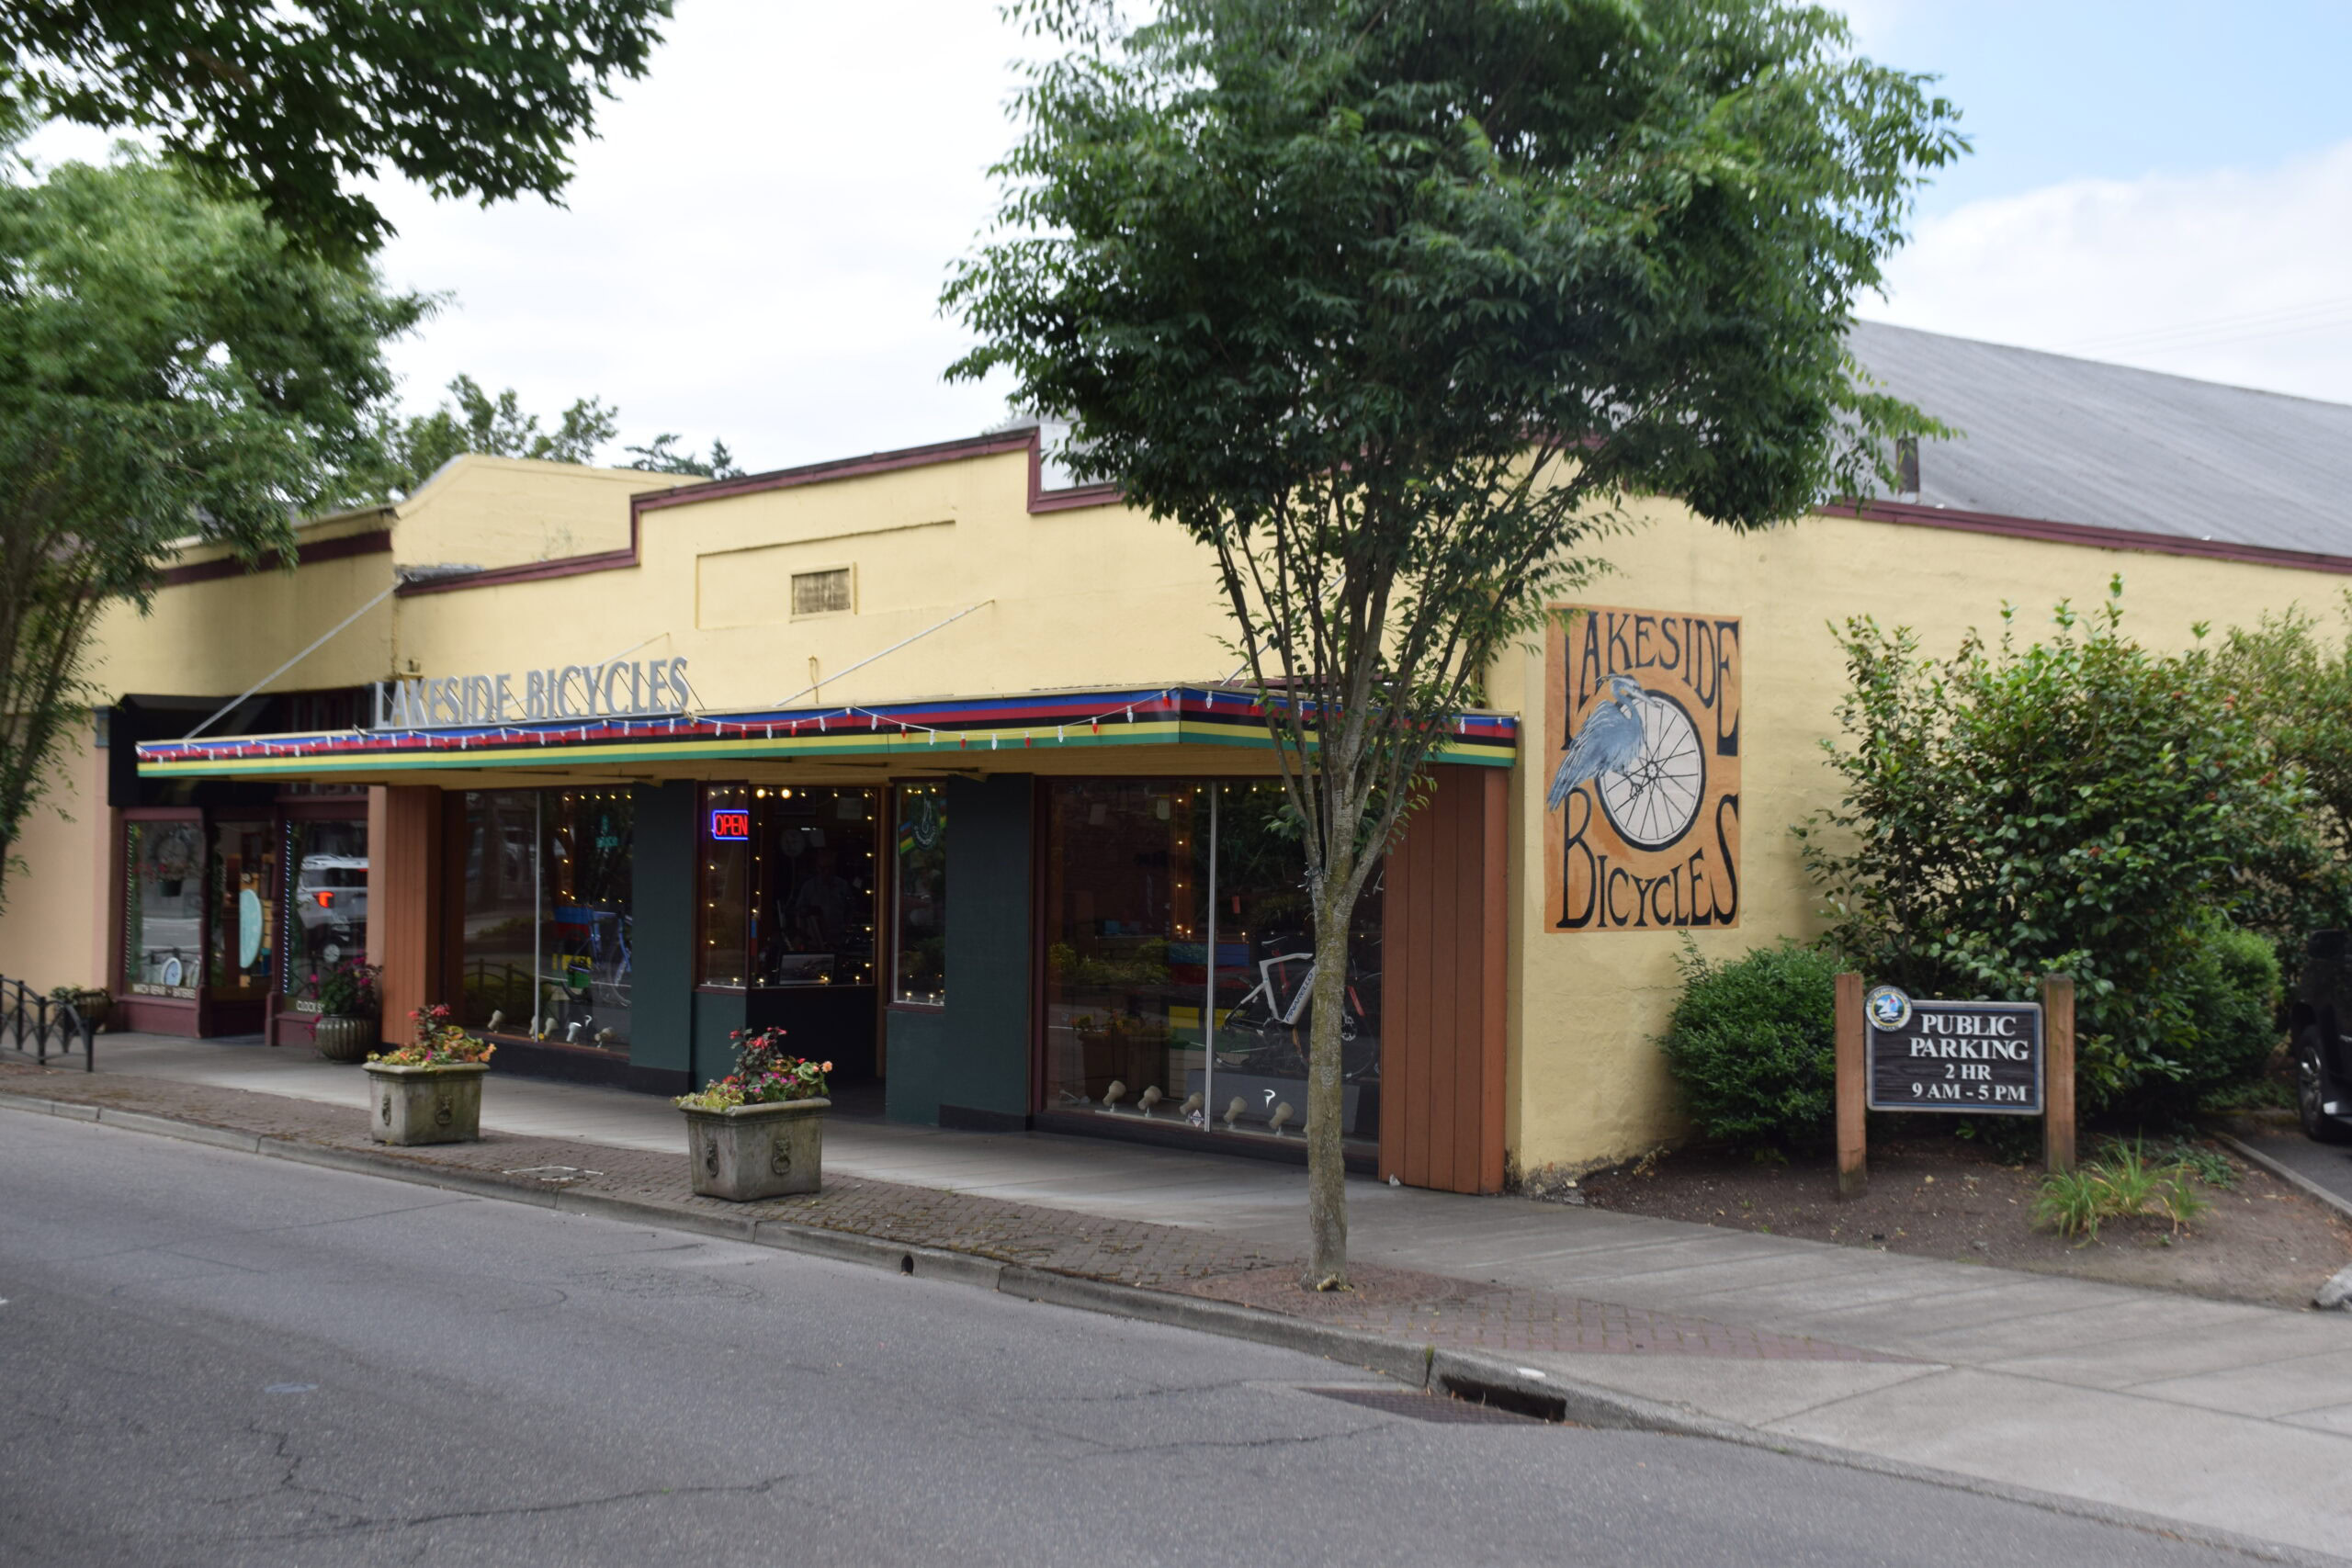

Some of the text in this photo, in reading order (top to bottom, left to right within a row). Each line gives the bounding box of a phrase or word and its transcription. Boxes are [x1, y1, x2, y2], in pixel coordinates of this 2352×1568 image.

[375, 657, 689, 728] LAKESIDE BICYCLES
[1560, 608, 1739, 757] LAKESIDE
[715, 814, 749, 836] OPEN
[1556, 786, 1738, 928] BICYCLES
[1286, 972, 1313, 1021] PINARELLO
[1921, 1014, 2017, 1036] PUBLIC
[1909, 1037, 2029, 1060] PARKING
[1945, 1064, 1992, 1080] 2 HR
[1912, 1082, 1923, 1098] 9
[1927, 1083, 1961, 1100] AM
[1978, 1085, 1989, 1100] 5
[1995, 1085, 2027, 1101] PM
